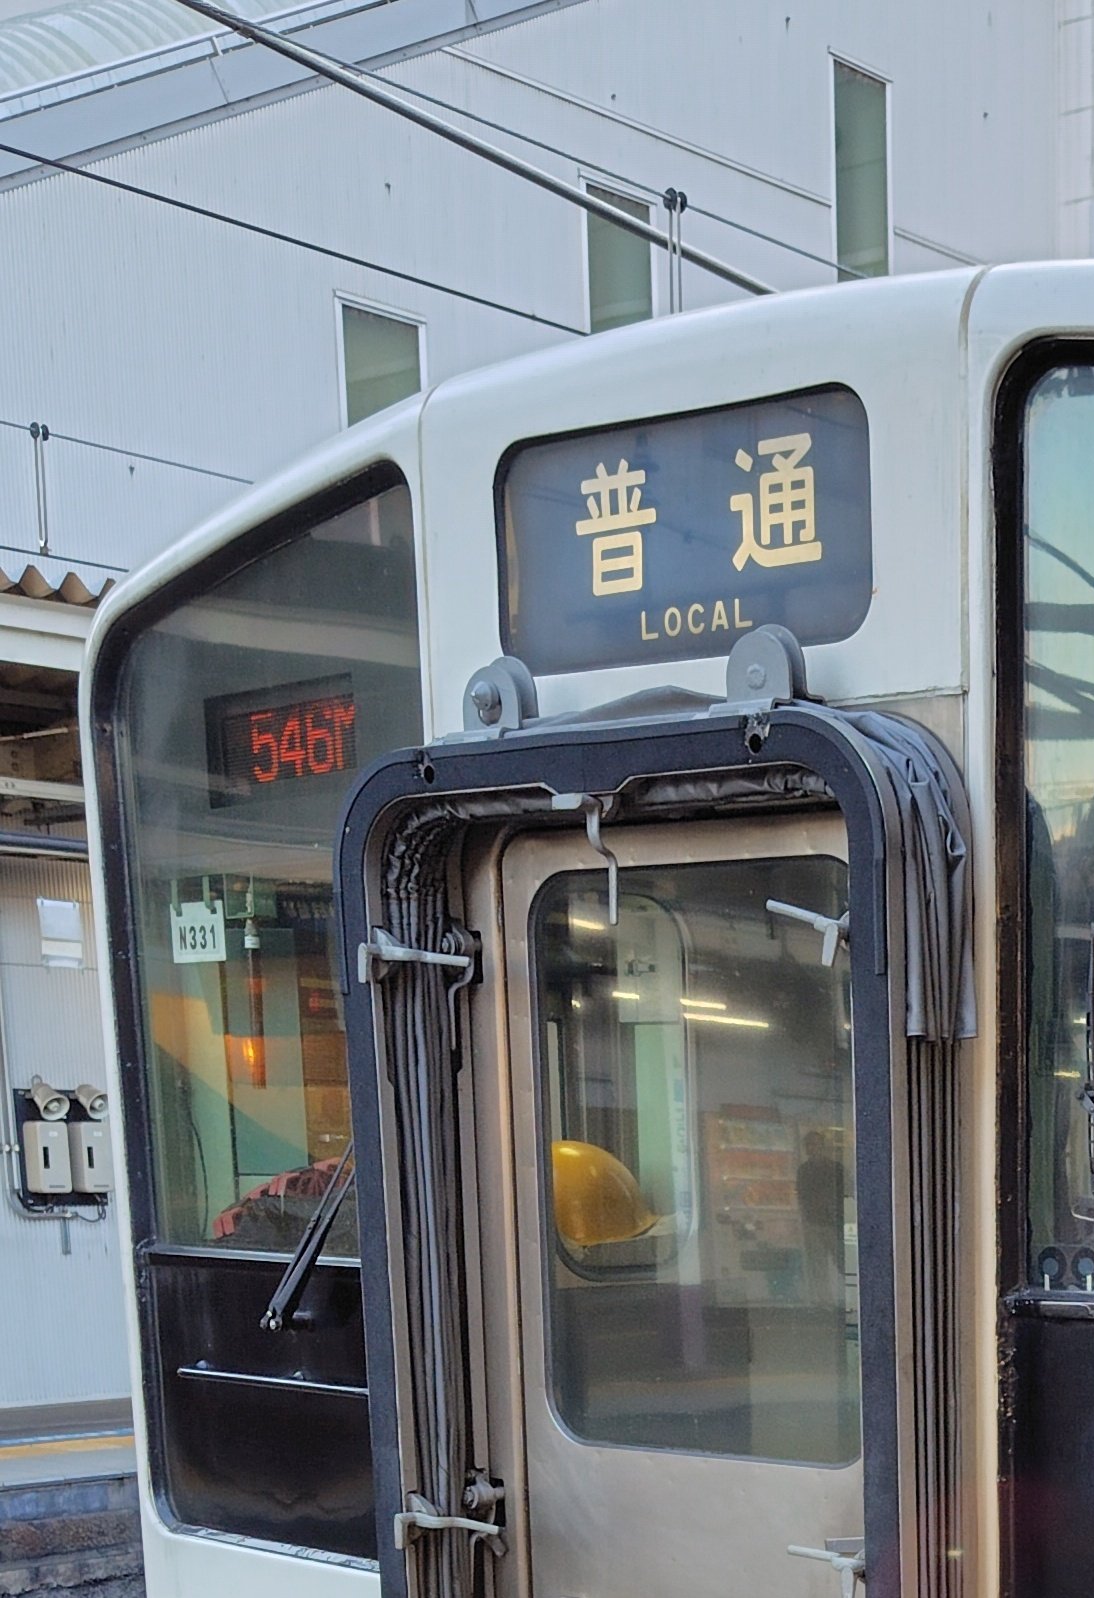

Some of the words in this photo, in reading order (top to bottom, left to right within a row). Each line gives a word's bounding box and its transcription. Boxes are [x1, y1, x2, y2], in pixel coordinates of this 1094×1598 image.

[576, 432, 822, 596] 普通
[641, 598, 753, 640] LOCAL
[179, 924, 216, 951] N331
